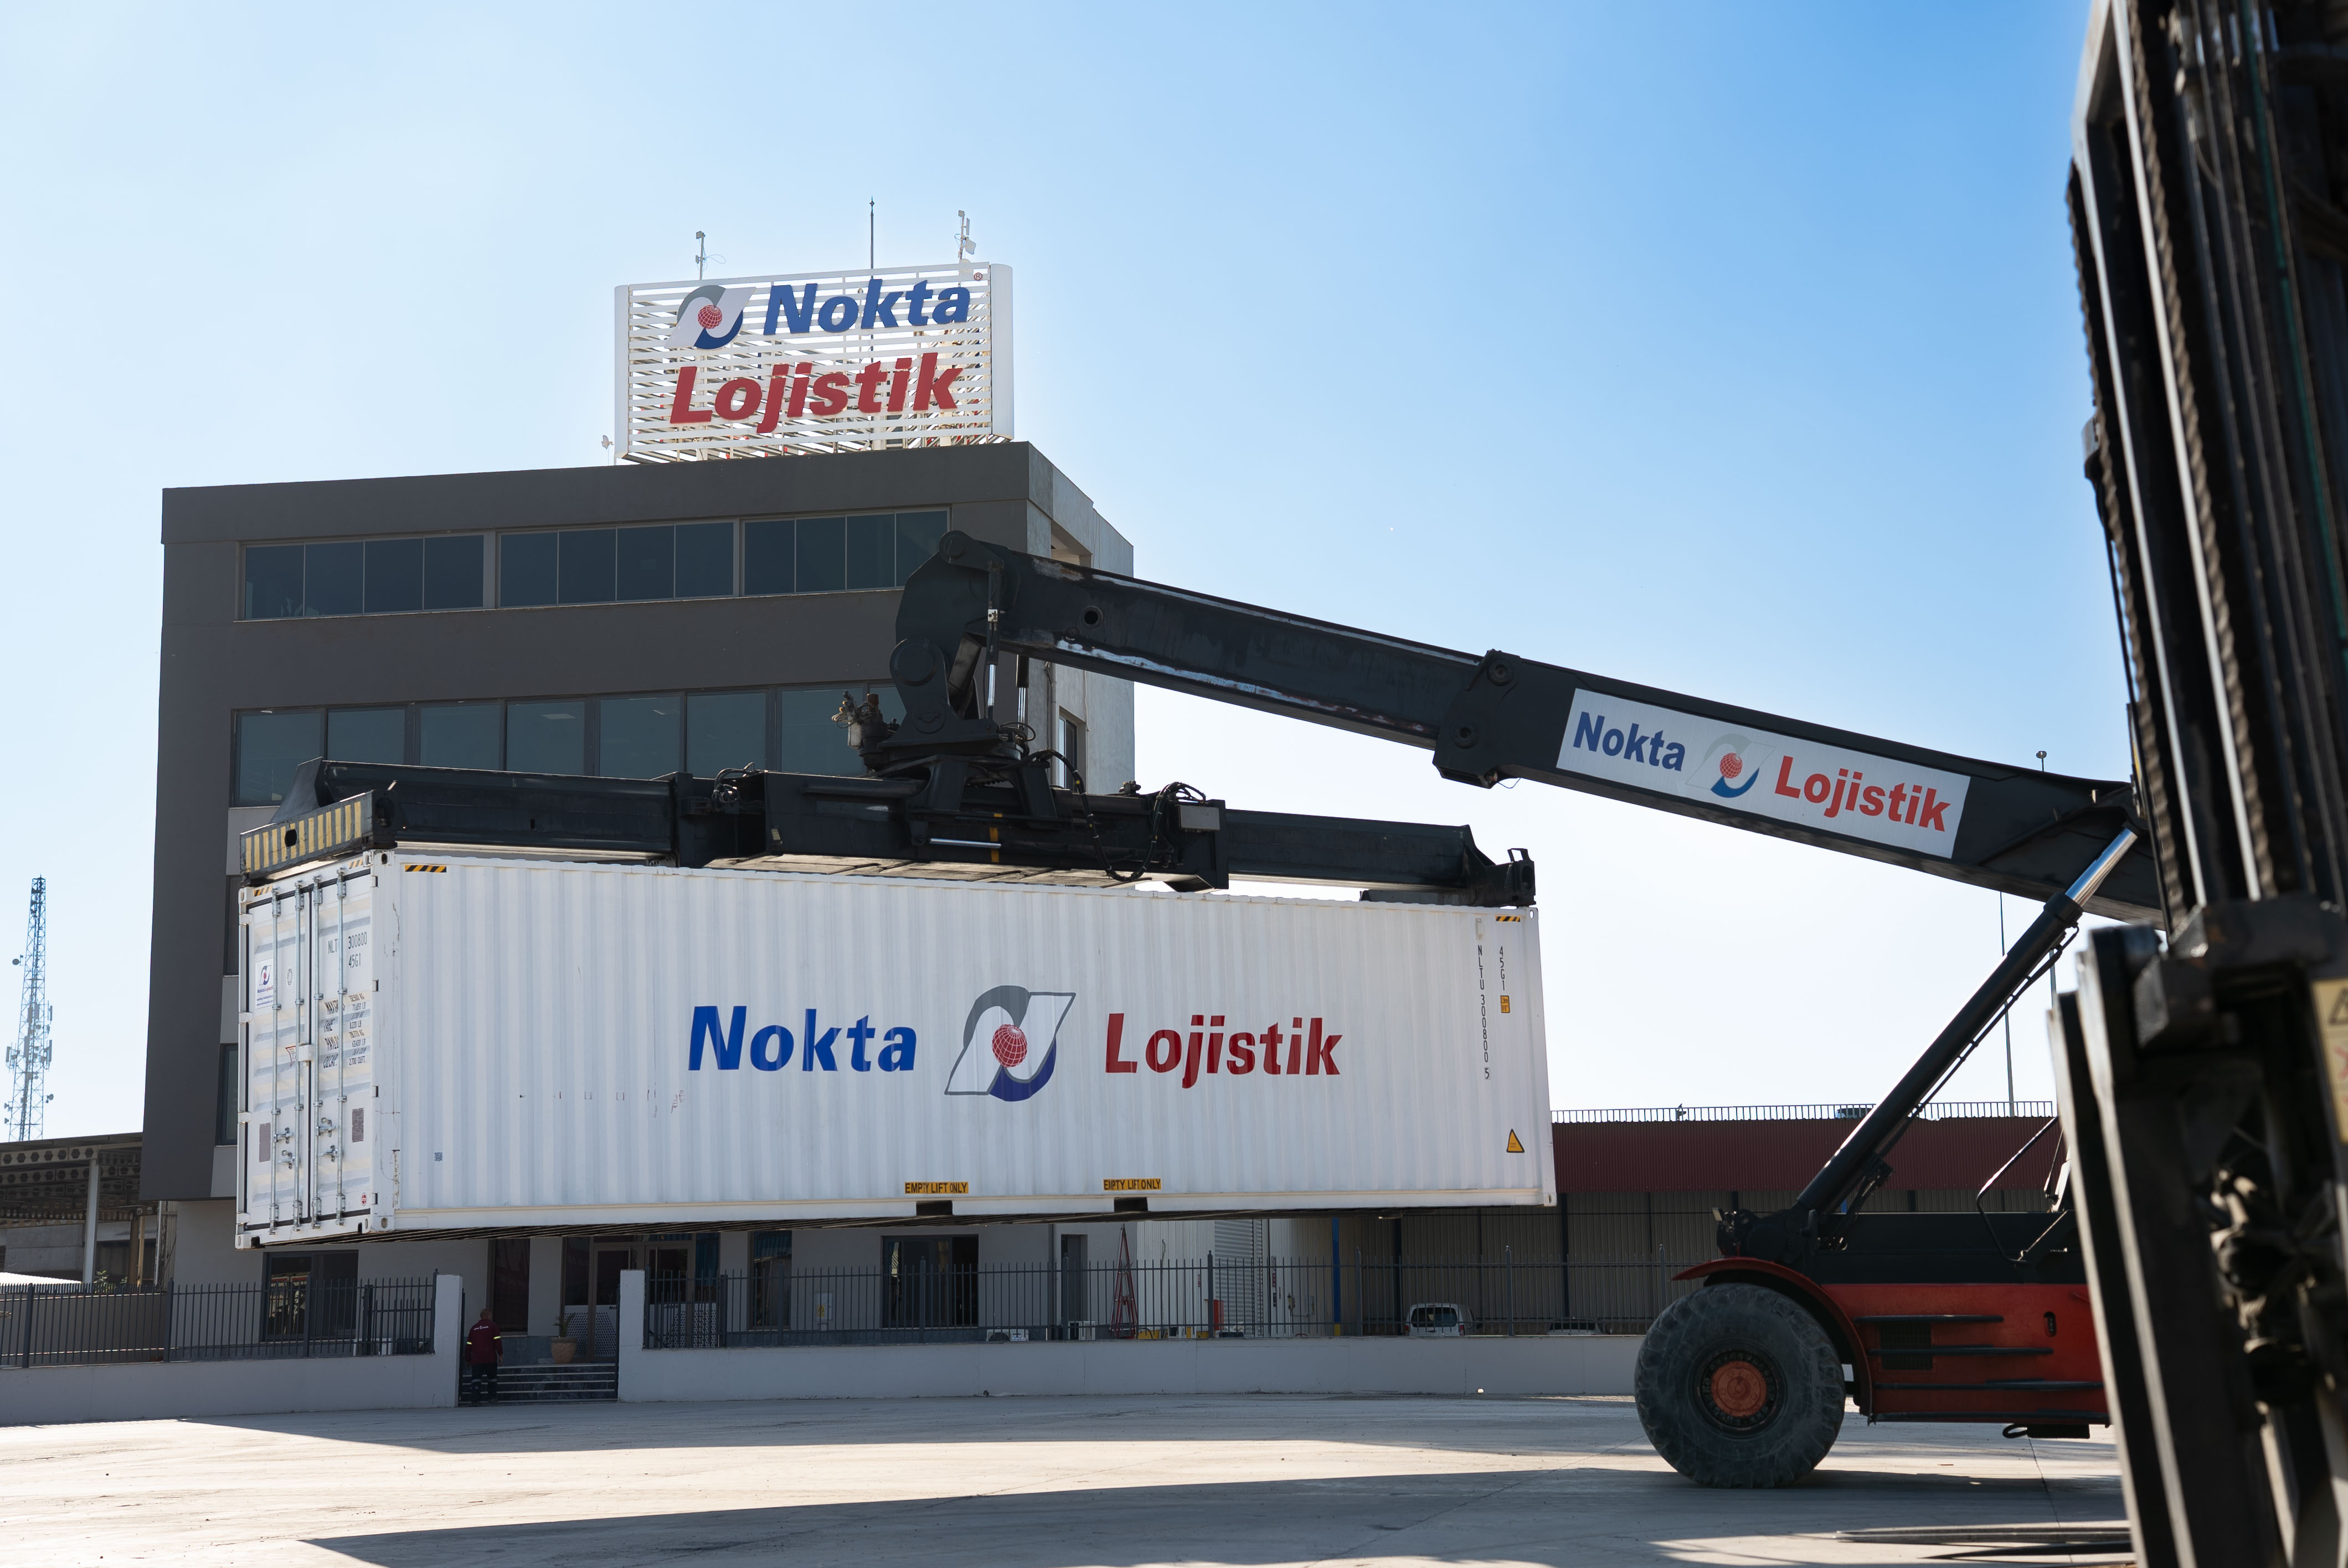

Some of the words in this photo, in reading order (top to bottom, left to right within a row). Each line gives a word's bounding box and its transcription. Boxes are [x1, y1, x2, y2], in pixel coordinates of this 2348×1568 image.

[764, 278, 971, 335] Nokta
[670, 353, 964, 434] Lojistik
[1573, 711, 1686, 771] Nokta
[1775, 755, 1951, 832] Lojistik
[328, 938, 338, 954] NLT
[348, 931, 367, 950] 300800
[348, 953, 361, 968] 45G1
[688, 1005, 916, 1072] Nokta
[1105, 1013, 1343, 1089] Lojistik
[905, 1183, 929, 1194] EMPTY
[931, 1183, 948, 1193] LIFT
[950, 1183, 967, 1193] ONLY
[1103, 1179, 1125, 1190] EMPTY
[1127, 1179, 1139, 1190] LIFT
[1141, 1179, 1161, 1190] ONLY
